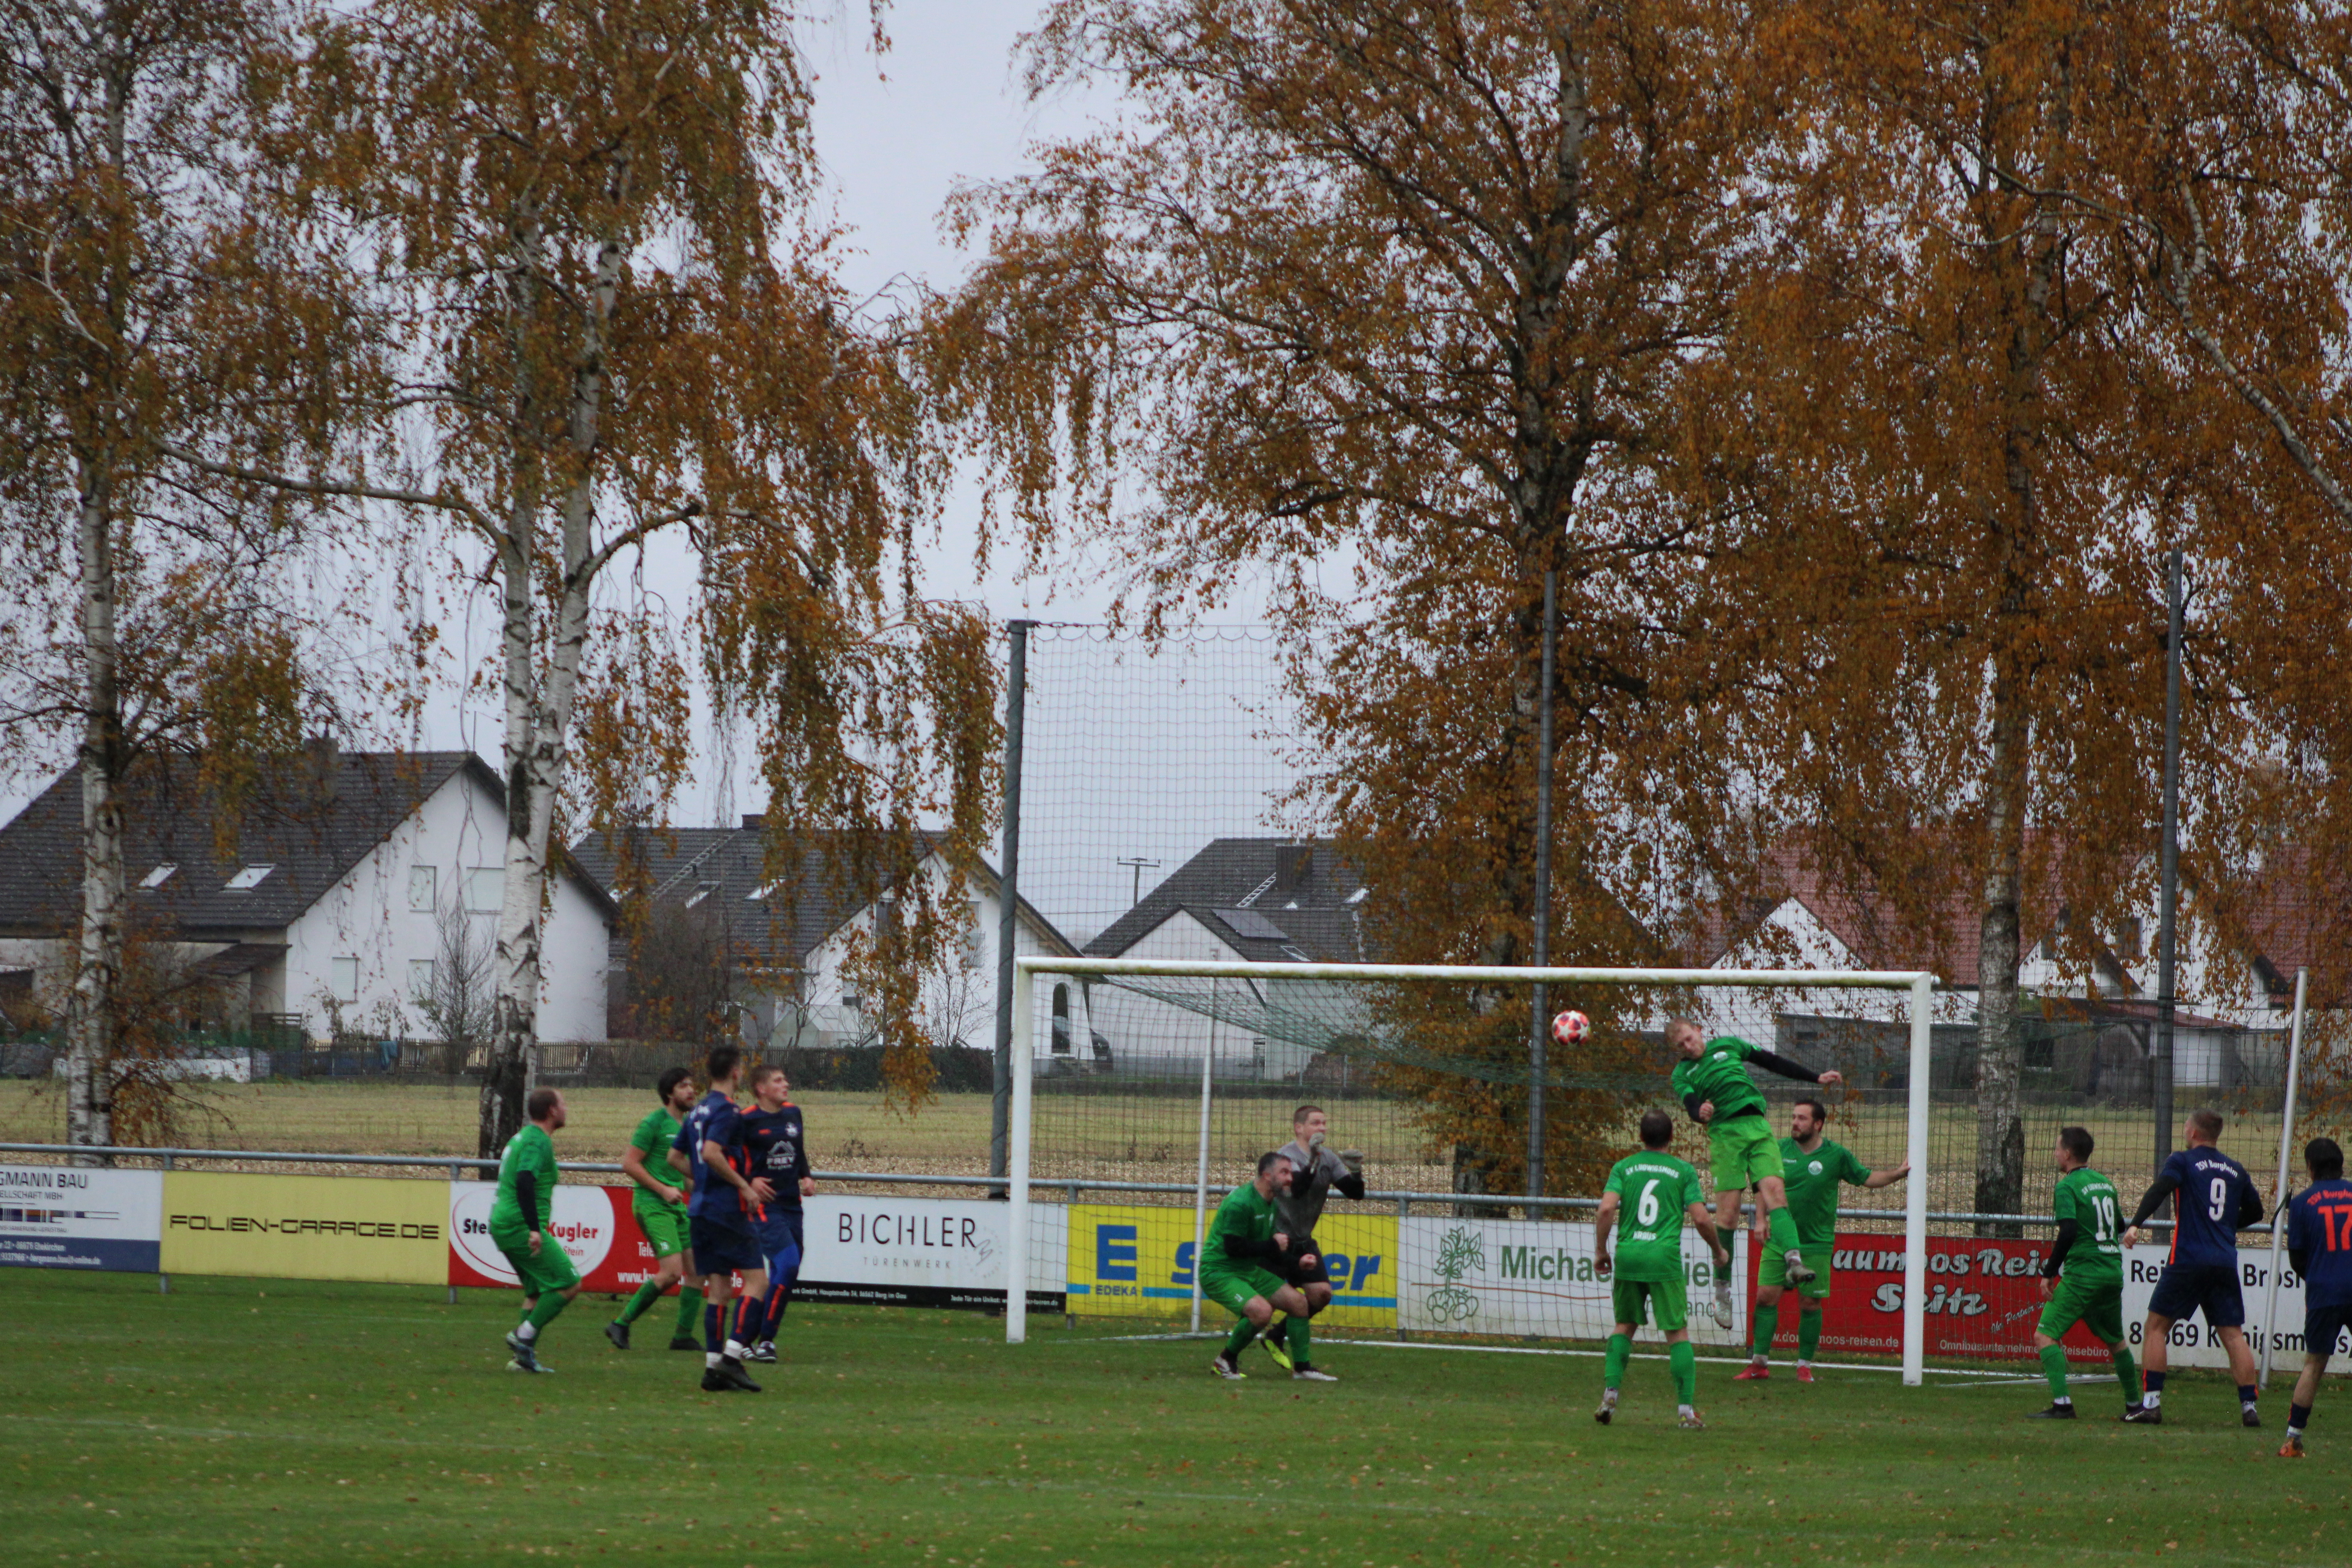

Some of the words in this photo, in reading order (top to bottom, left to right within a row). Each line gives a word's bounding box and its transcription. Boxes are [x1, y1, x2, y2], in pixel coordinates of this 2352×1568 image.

[2195, 1160, 2208, 1171] TSV
[2208, 1159, 2238, 1178] Burgheim
[58, 1173, 87, 1188] BAU
[1637, 1179, 1660, 1227] 6
[2209, 1178, 2226, 1221] 9
[170, 1214, 439, 1239] FOLIEN-GARAGE.DE
[838, 1212, 976, 1248] BICHLER
[2092, 1196, 2114, 1241] 19
[2318, 1204, 2352, 1252] 17
[546, 1221, 598, 1242] Kugler
[864, 1256, 951, 1269] TÜRENWERK
[1097, 1225, 1136, 1280] E
[1096, 1285, 1137, 1296] EDEKA
[2005, 1306, 2034, 1325] Partner
[1940, 1339, 2038, 1353] Omnibusunternehme
[2062, 1345, 2109, 1357] Reisebüro
